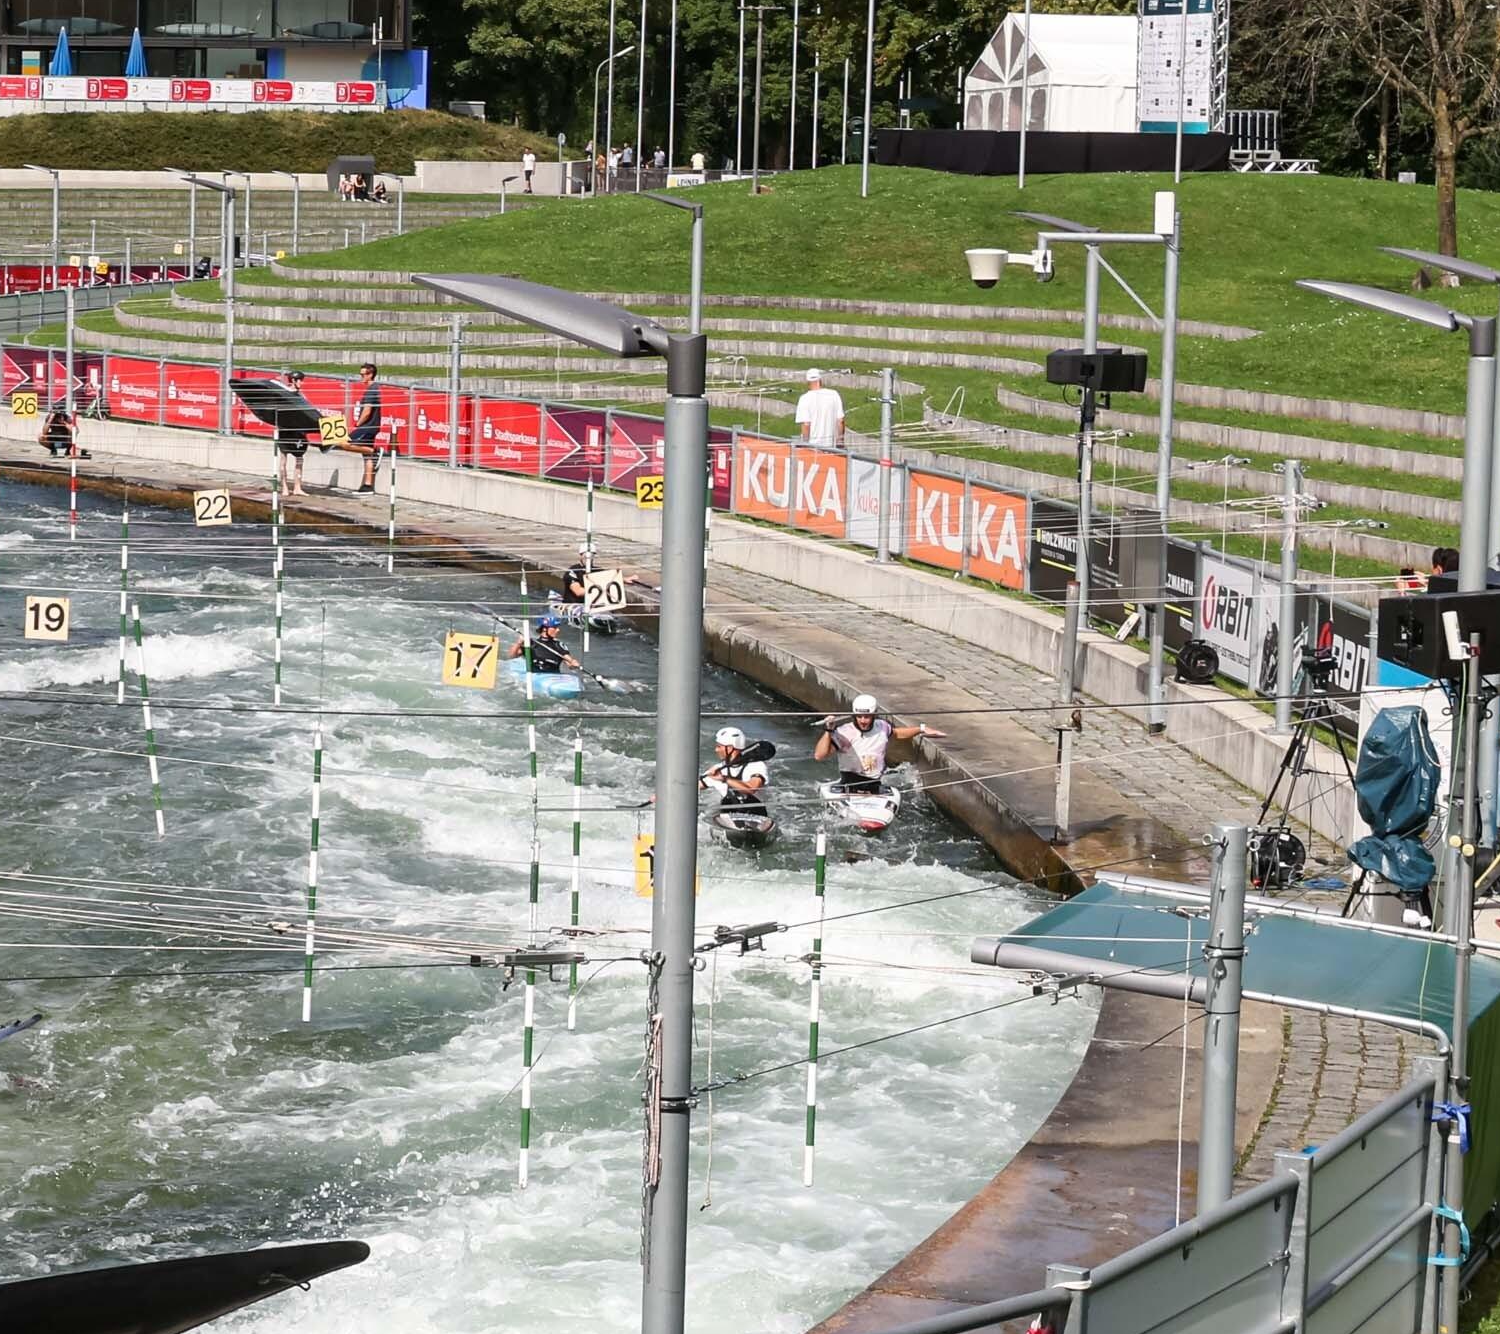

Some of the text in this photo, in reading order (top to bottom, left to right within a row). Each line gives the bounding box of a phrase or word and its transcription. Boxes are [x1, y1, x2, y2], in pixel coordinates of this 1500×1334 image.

[13, 397, 36, 415] 26
[321, 419, 346, 440] 25
[494, 429, 537, 446] Stadtsparkasse
[494, 445, 522, 462] Augsburg
[639, 481, 664, 503] 23
[742, 448, 844, 522] KUKA
[196, 496, 229, 521] 22
[857, 490, 901, 517] kukam
[915, 487, 1023, 570] KUKA
[587, 581, 623, 608] 20
[1167, 573, 1194, 596] ZWARTH
[28, 603, 66, 631] 19
[1203, 575, 1252, 641] ORBIT
[449, 642, 493, 679] 17
